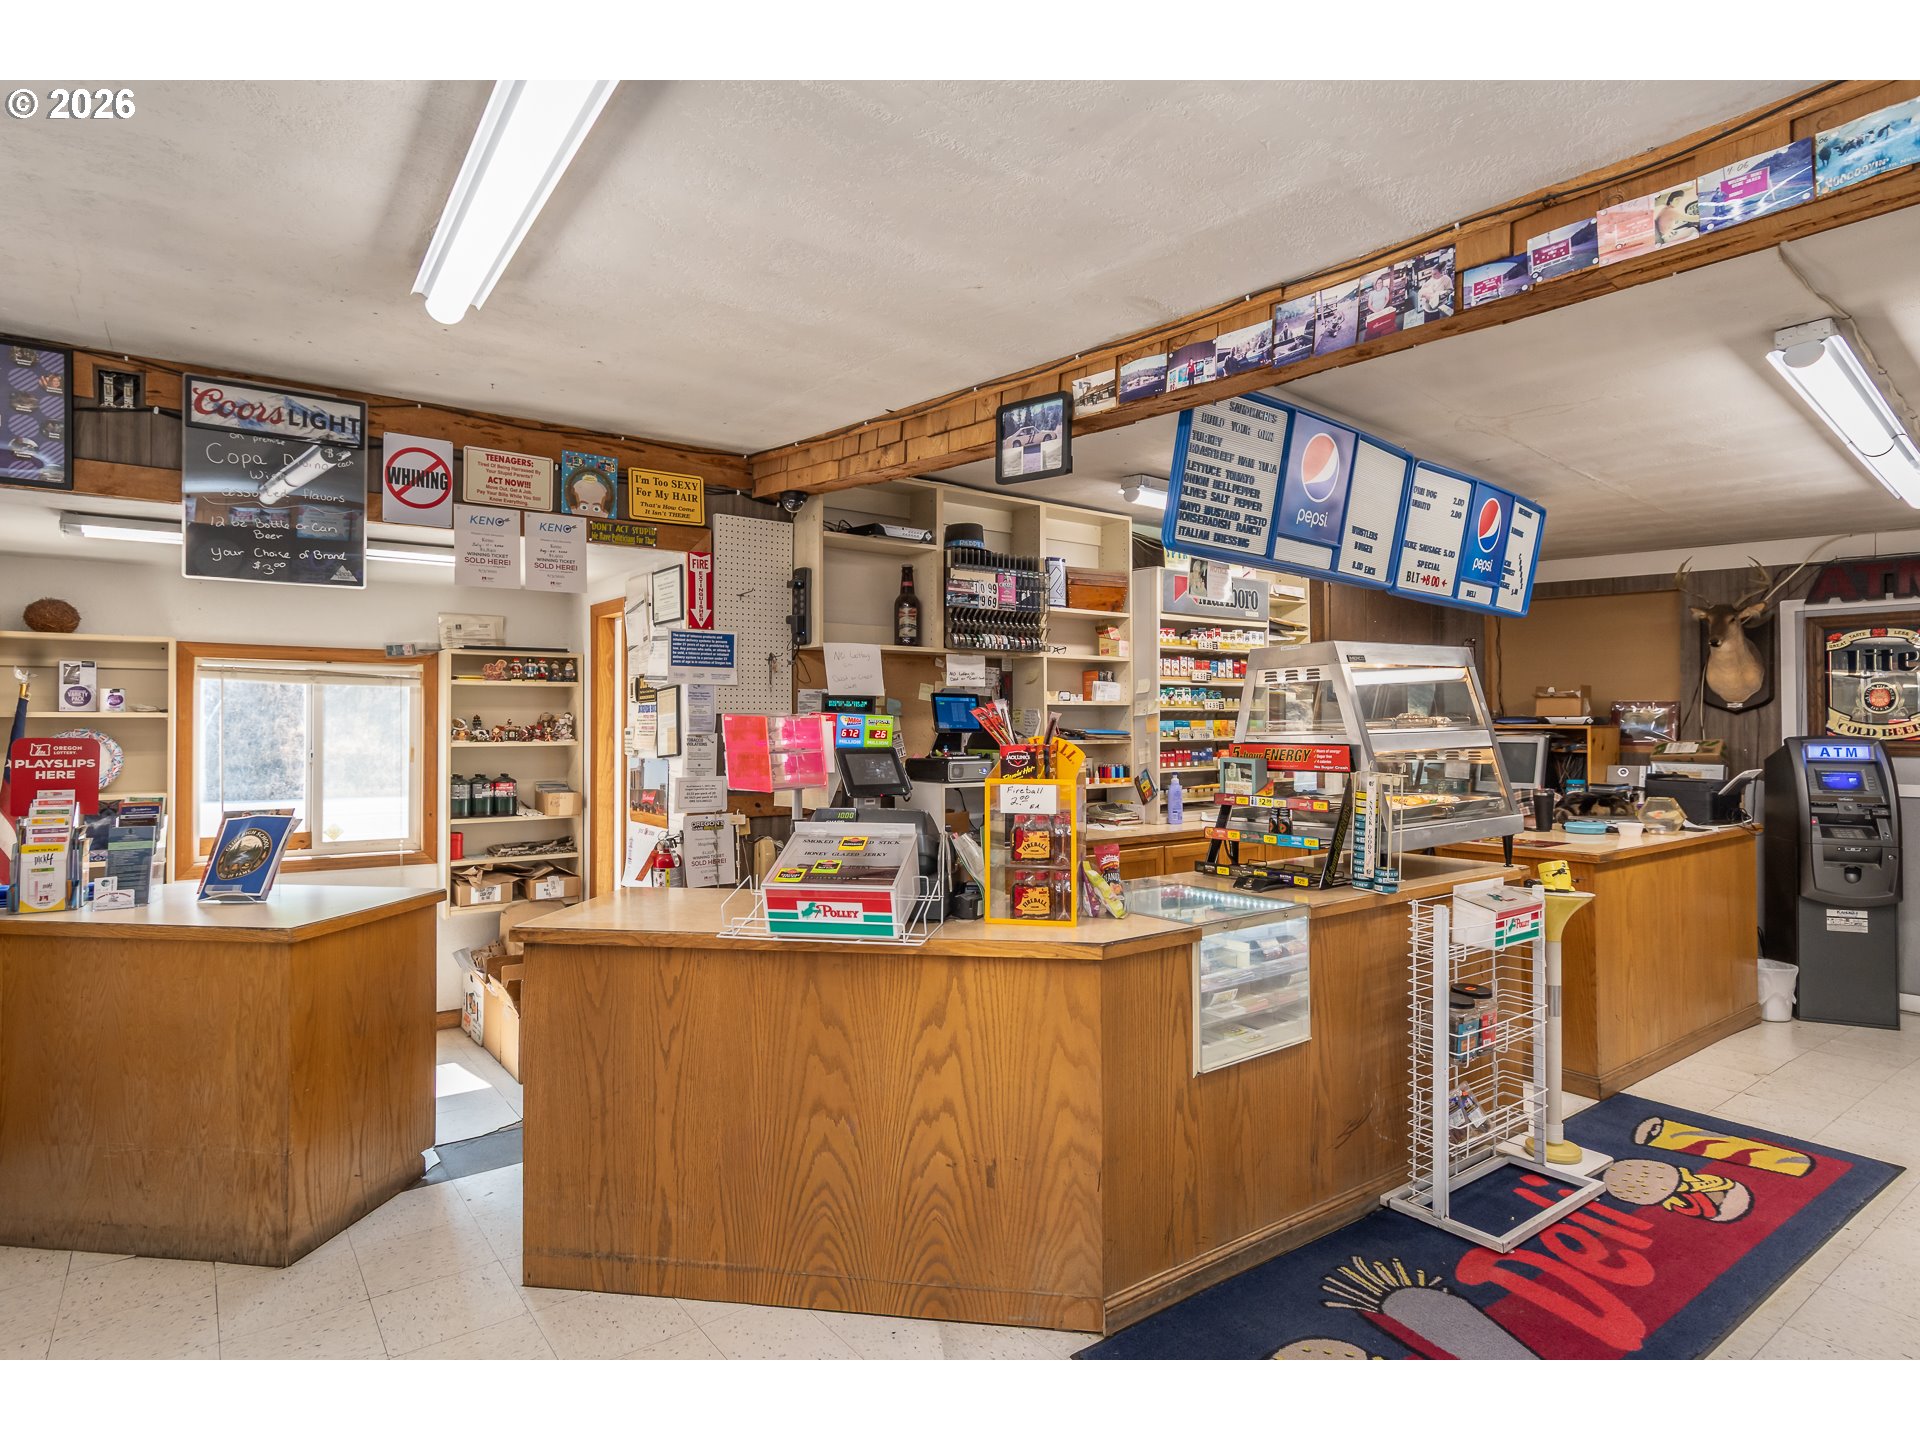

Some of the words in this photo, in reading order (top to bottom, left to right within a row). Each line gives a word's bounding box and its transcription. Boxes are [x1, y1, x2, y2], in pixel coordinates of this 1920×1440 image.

[192, 387, 286, 425] Coors
[288, 408, 361, 435] LIGHT
[1229, 401, 1277, 423] SANDWICHES
[1201, 412, 1225, 427] BUILD
[1192, 430, 1223, 447] TURKEY
[205, 442, 268, 469] Copa
[485, 454, 534, 467] TEENAGERS:
[1187, 460, 1222, 477] LETTUCE
[1225, 469, 1255, 485] TOMATO
[1258, 461, 1277, 474] TUNA
[386, 465, 449, 491] WHINING
[488, 476, 503, 484] ACT
[505, 479, 531, 489] NOW!!!
[635, 475, 650, 484] I'm
[653, 477, 668, 487] Too
[671, 478, 698, 491] SEXY
[1184, 472, 1209, 487] ONION
[302, 488, 345, 503] flavors
[636, 487, 651, 497] For
[655, 489, 669, 500] My
[672, 491, 698, 503] HAIR
[1181, 485, 1207, 499] OLIVES
[1210, 492, 1230, 504] SALT
[1234, 497, 1263, 512] PEPPER
[1425, 488, 1438, 499] DOG
[1452, 497, 1465, 507] 2.00
[640, 501, 661, 509] That's
[470, 515, 504, 526] KENO
[668, 511, 690, 519] THERE
[1179, 500, 1201, 513] MAYO
[1204, 505, 1240, 521] MUSTARD
[1244, 514, 1267, 527] PESTO
[1296, 507, 1329, 528] pepsi
[209, 516, 226, 527] 12
[252, 518, 291, 530] Bottle
[295, 521, 309, 530] or
[311, 522, 338, 534] Can
[540, 522, 572, 533] KENO
[592, 523, 612, 531] DON'T
[616, 525, 629, 533] ACT
[632, 527, 656, 535] STUPID
[1236, 522, 1261, 536] RANCH
[252, 530, 284, 540] Beer
[1178, 525, 1210, 540] ITALIAN
[1213, 533, 1249, 548] DRESSING
[209, 547, 245, 562] Your
[298, 549, 310, 559] of
[313, 550, 348, 561] Brand
[487, 558, 511, 566] HERE!
[692, 558, 709, 570] FIRE
[1416, 560, 1441, 572] SPECIAL
[1472, 557, 1494, 573] pepsi
[1406, 570, 1421, 584] BLT
[1848, 631, 1867, 639] TASTE
[1838, 722, 1878, 737] COLD
[1264, 748, 1313, 763] ENERGY
[1819, 747, 1858, 758] ATM
[14, 758, 96, 769] PLAYSLIPS
[34, 770, 76, 780] HERE
[1006, 786, 1044, 794] Fireball
[1022, 842, 1048, 851] FIREBALL
[1022, 898, 1048, 907] FIREBALL
[1456, 1172, 1655, 1353] Deli
